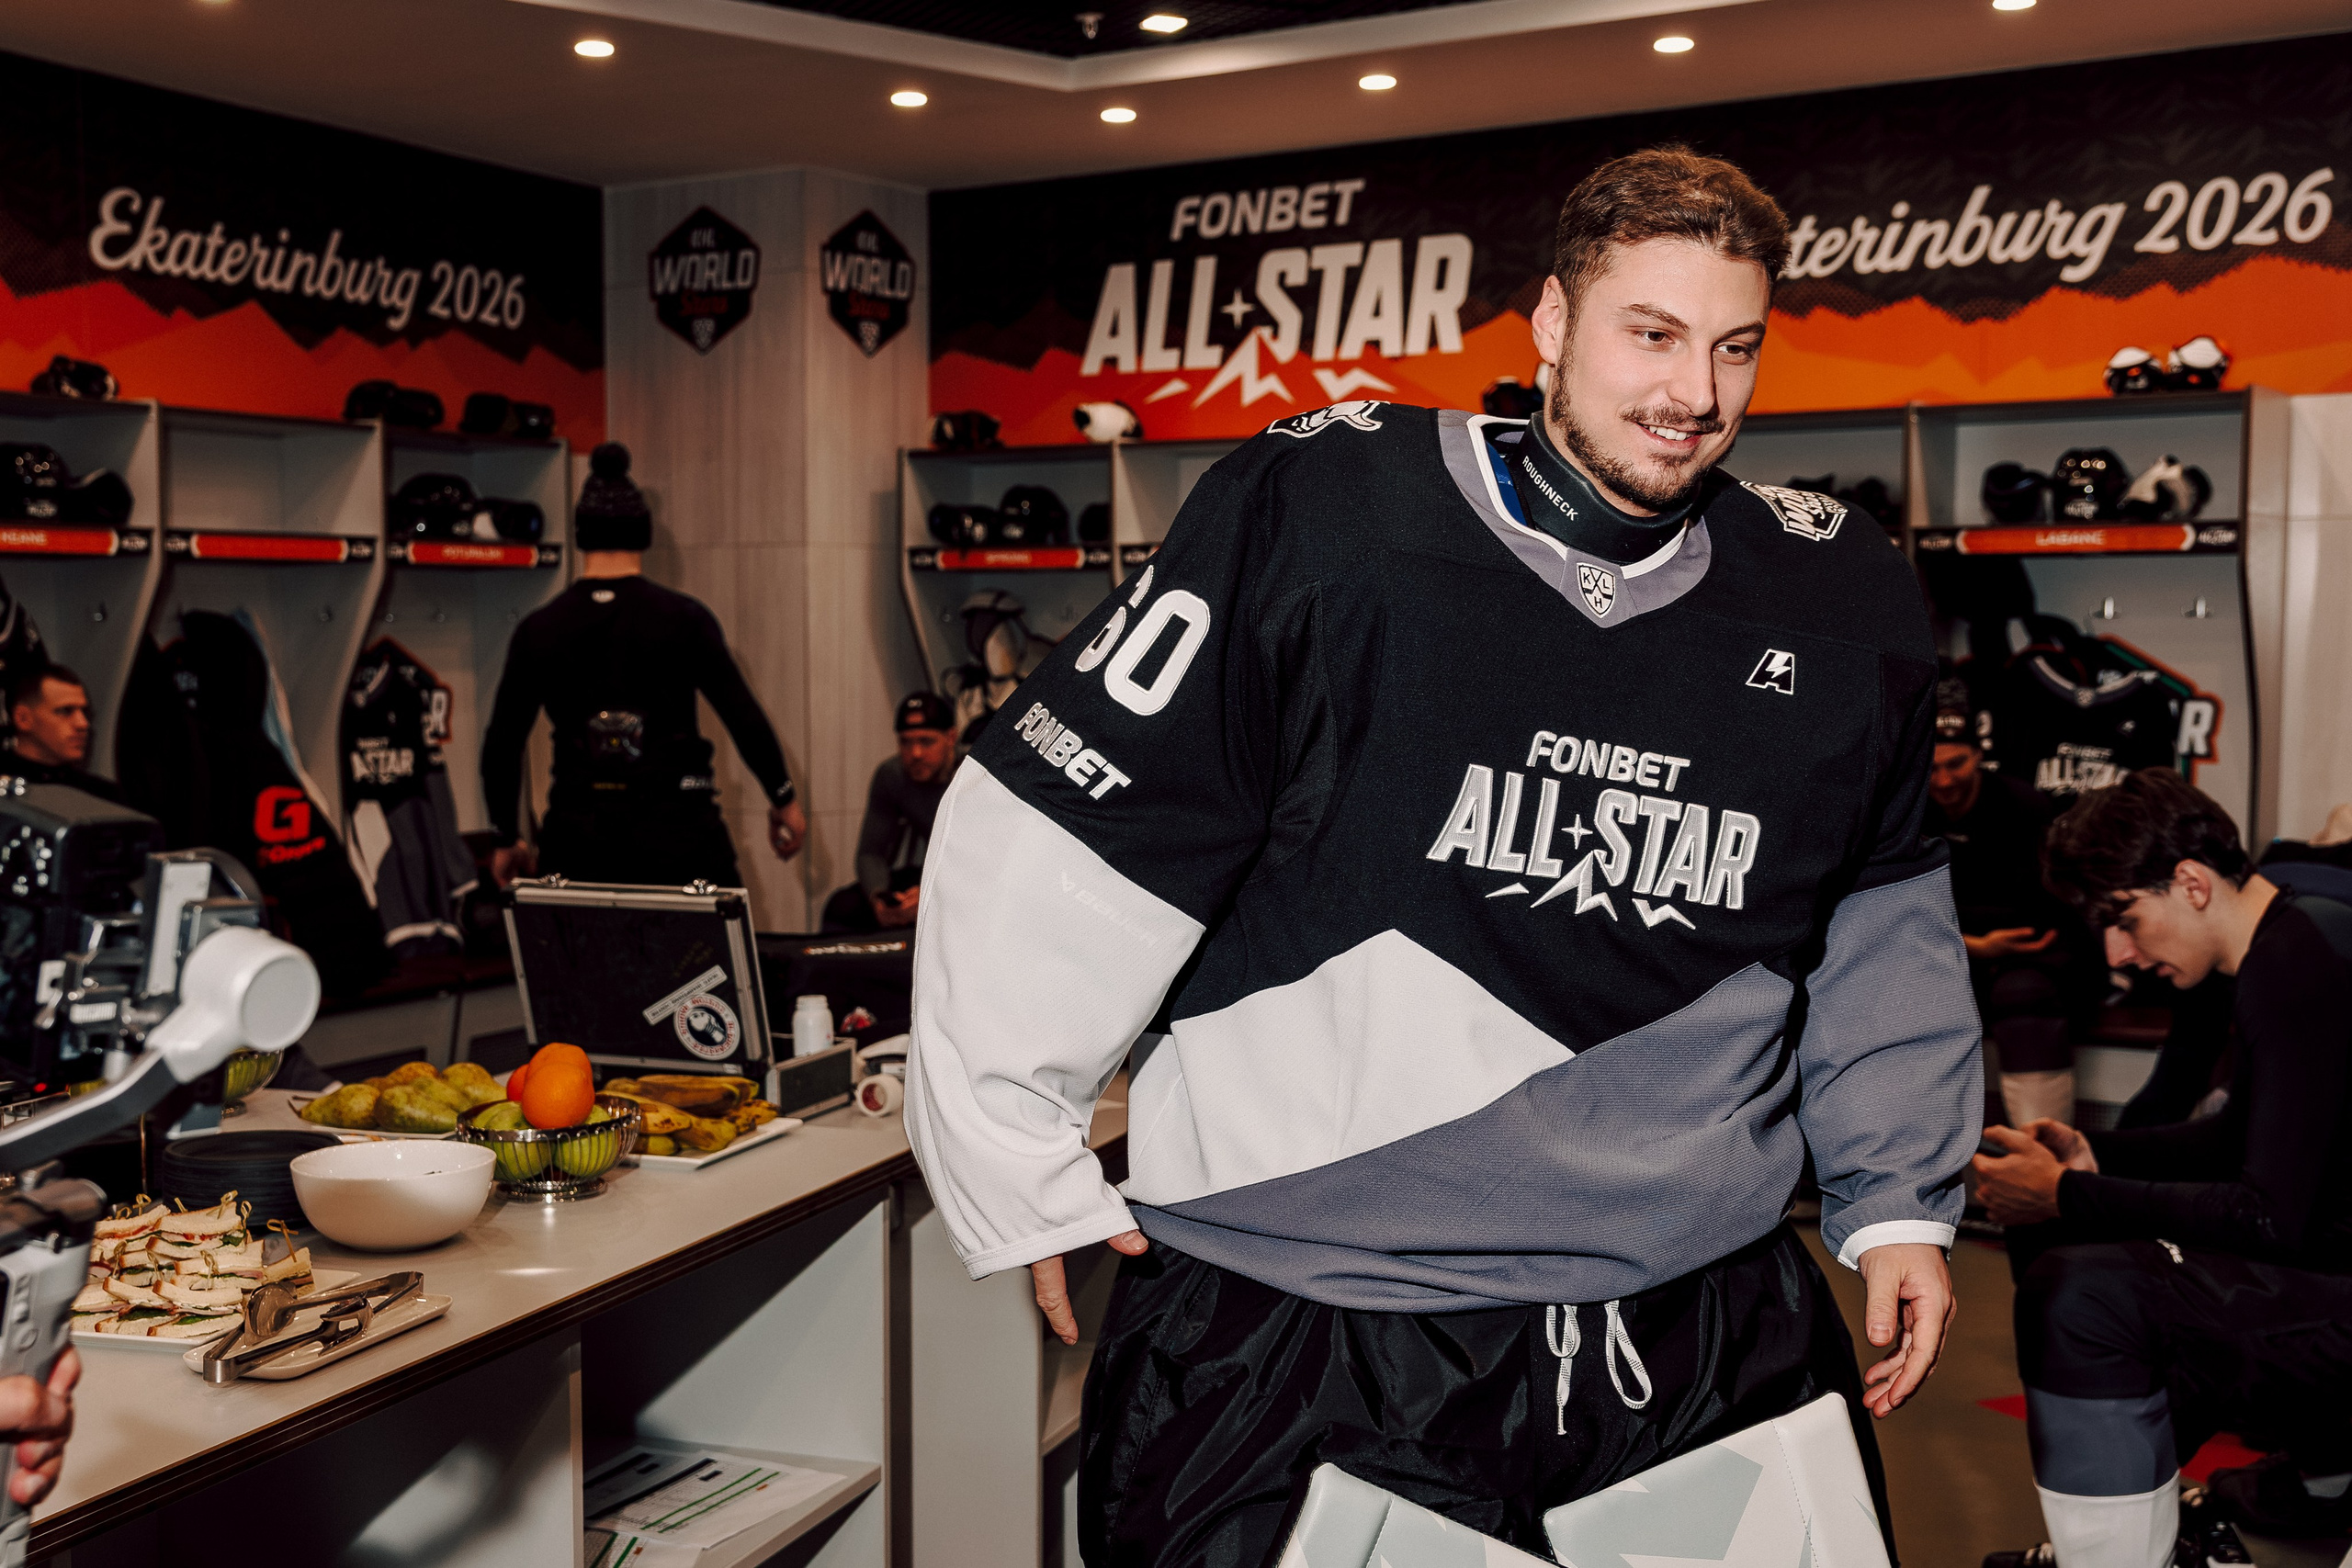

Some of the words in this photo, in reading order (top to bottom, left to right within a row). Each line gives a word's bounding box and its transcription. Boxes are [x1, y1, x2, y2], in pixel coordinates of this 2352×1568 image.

[1170, 178, 1365, 243] FONBET
[1779, 184, 2128, 284] terinburg
[2133, 167, 2335, 254] 2026
[89, 186, 421, 331] Ekaterinburg
[428, 260, 526, 329] 2026
[653, 248, 756, 296] WORLD
[825, 250, 912, 299] WORLD
[1080, 254, 1225, 378] ALL
[1254, 231, 1475, 366] STAR
[1521, 455, 1579, 522] ROUGHNECK
[1012, 701, 1133, 800] FONBET
[1526, 730, 1691, 793] FONBET
[1425, 763, 1564, 879] ALL
[1593, 787, 1762, 912] STAR
